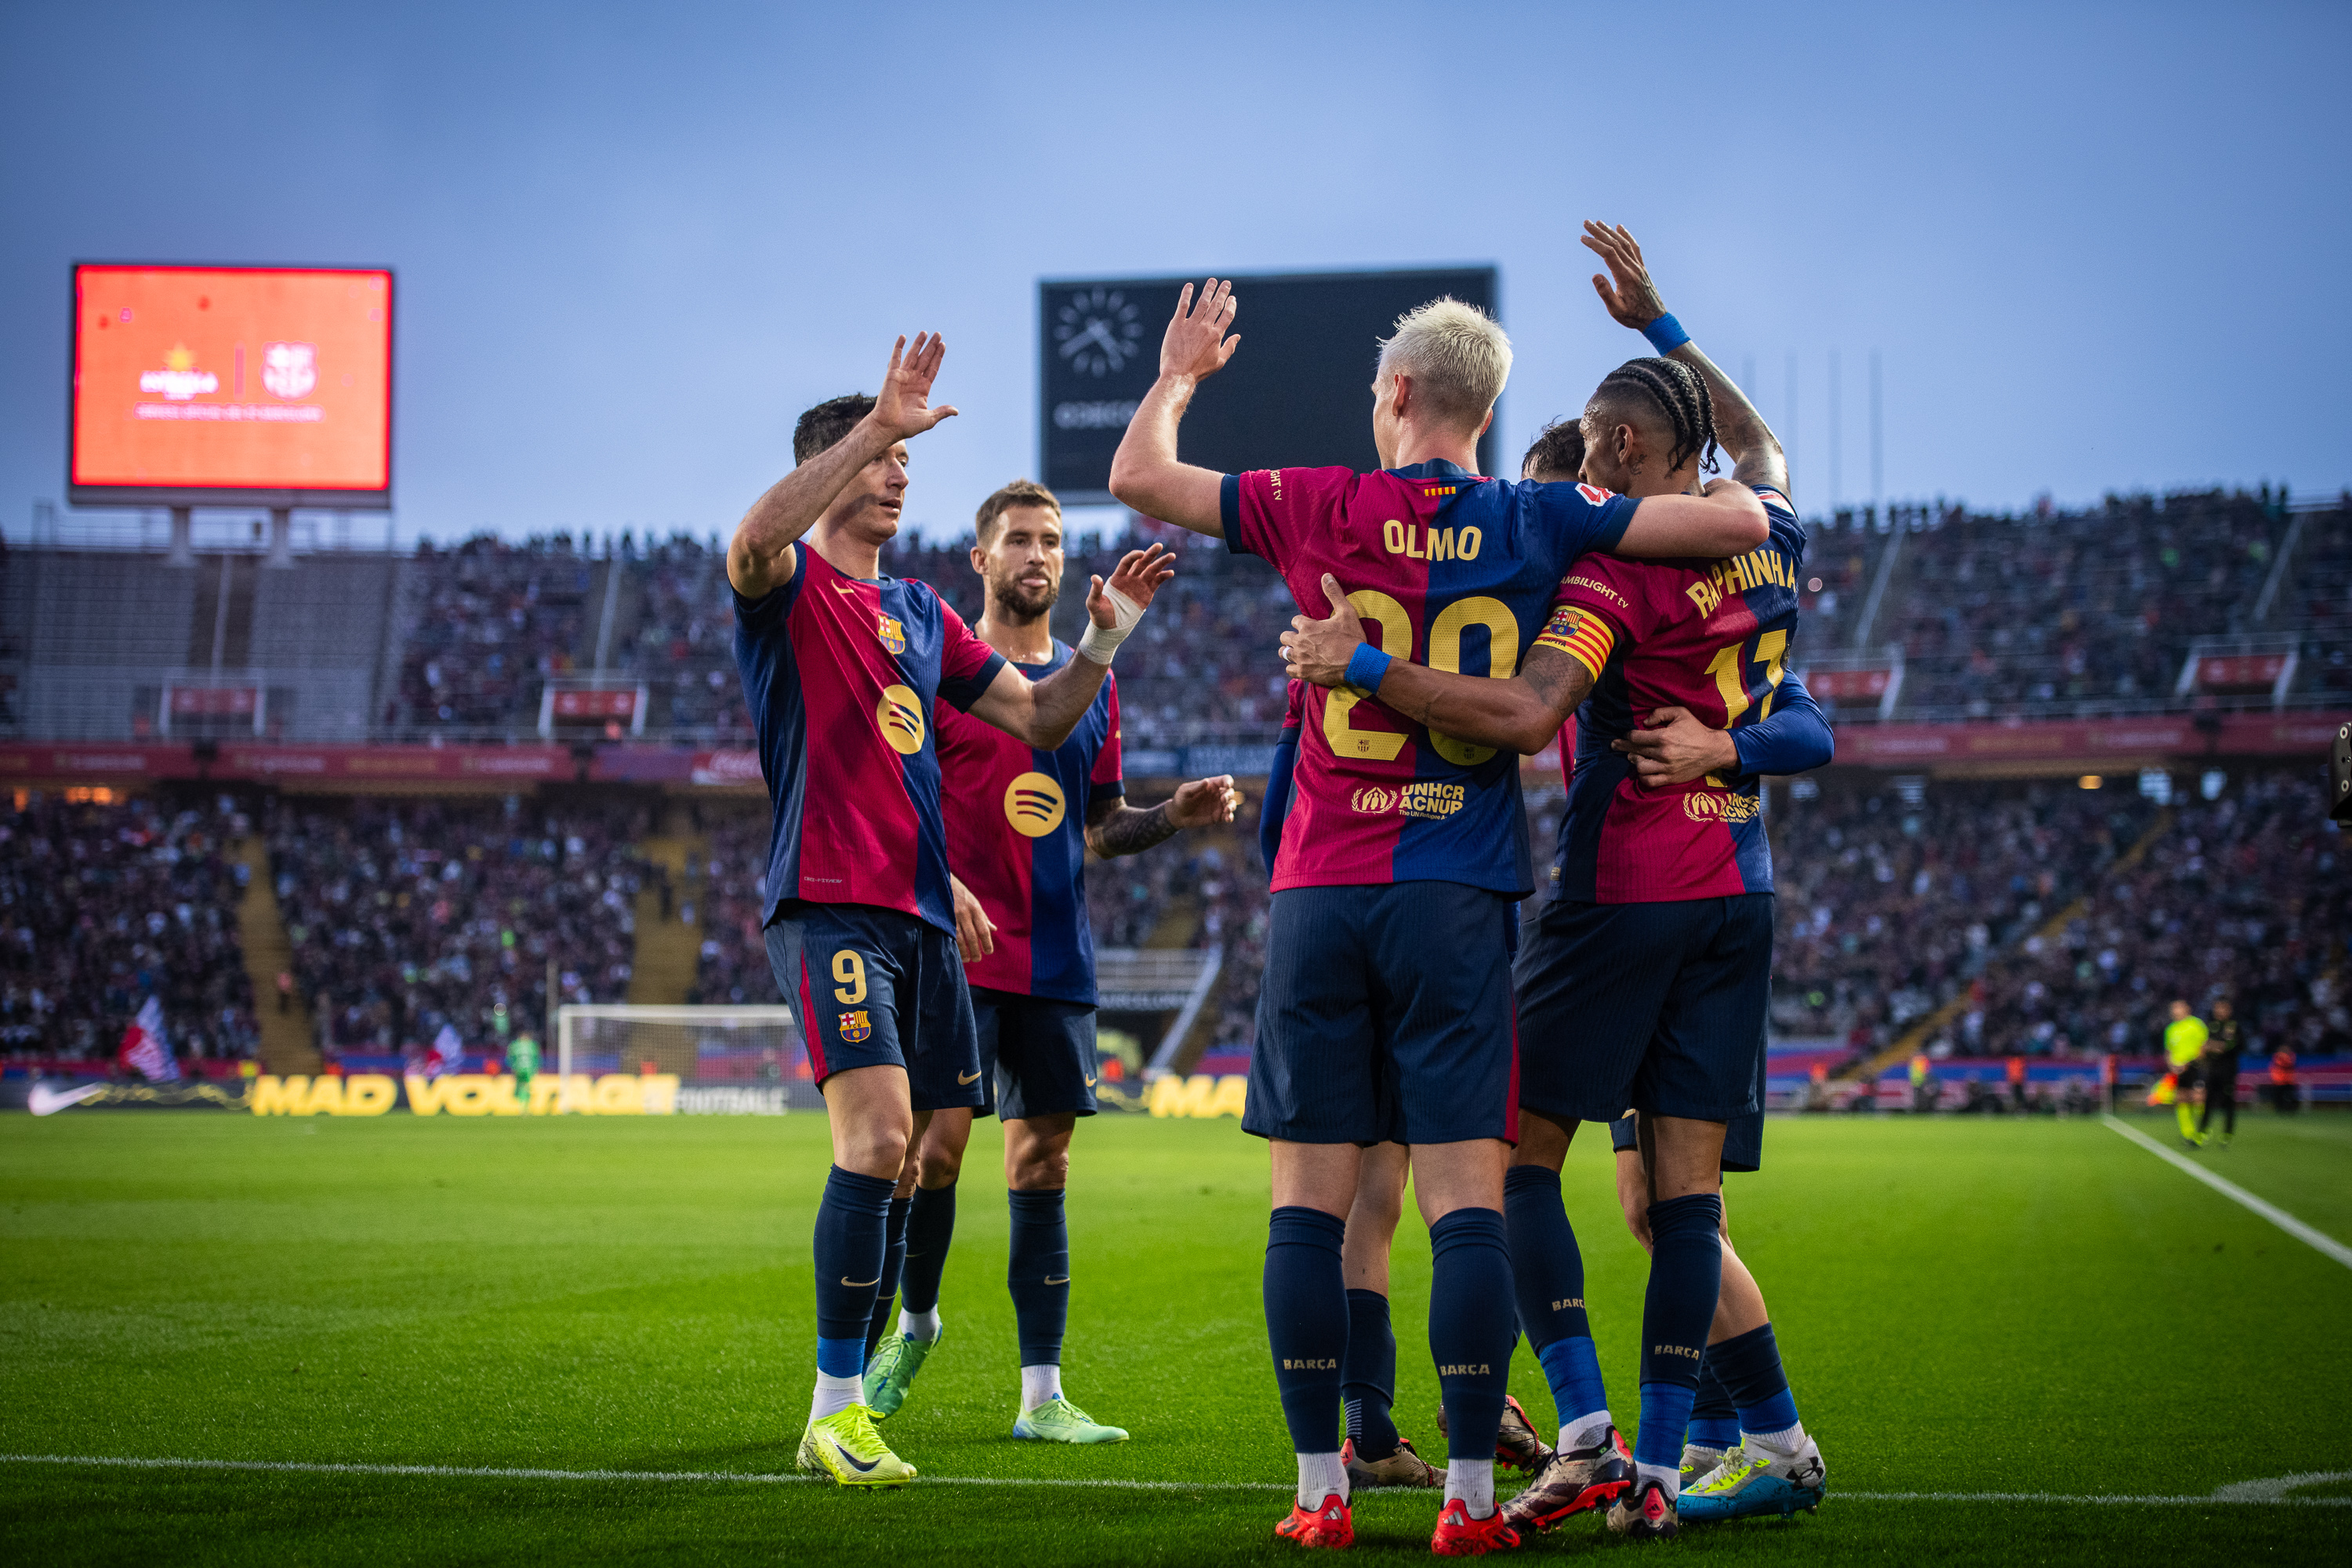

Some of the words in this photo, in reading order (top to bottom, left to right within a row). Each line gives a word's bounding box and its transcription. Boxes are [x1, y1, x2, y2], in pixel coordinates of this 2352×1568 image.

[1383, 519, 1483, 561] OLMO
[1559, 576, 1617, 601] AMBILIGHT
[1617, 597, 1629, 608] tv
[1686, 550, 1796, 619] RAPHINHA
[1323, 590, 1519, 766] 20
[1401, 782, 1465, 801] UNHCR
[832, 949, 867, 1004] 9
[251, 1074, 398, 1116] MAD
[1552, 1298, 1586, 1312] BARÇ
[1283, 1359, 1337, 1370] BARÇA
[1654, 1345, 1700, 1360] BARÇA
[1439, 1364, 1490, 1377] BARÇA
